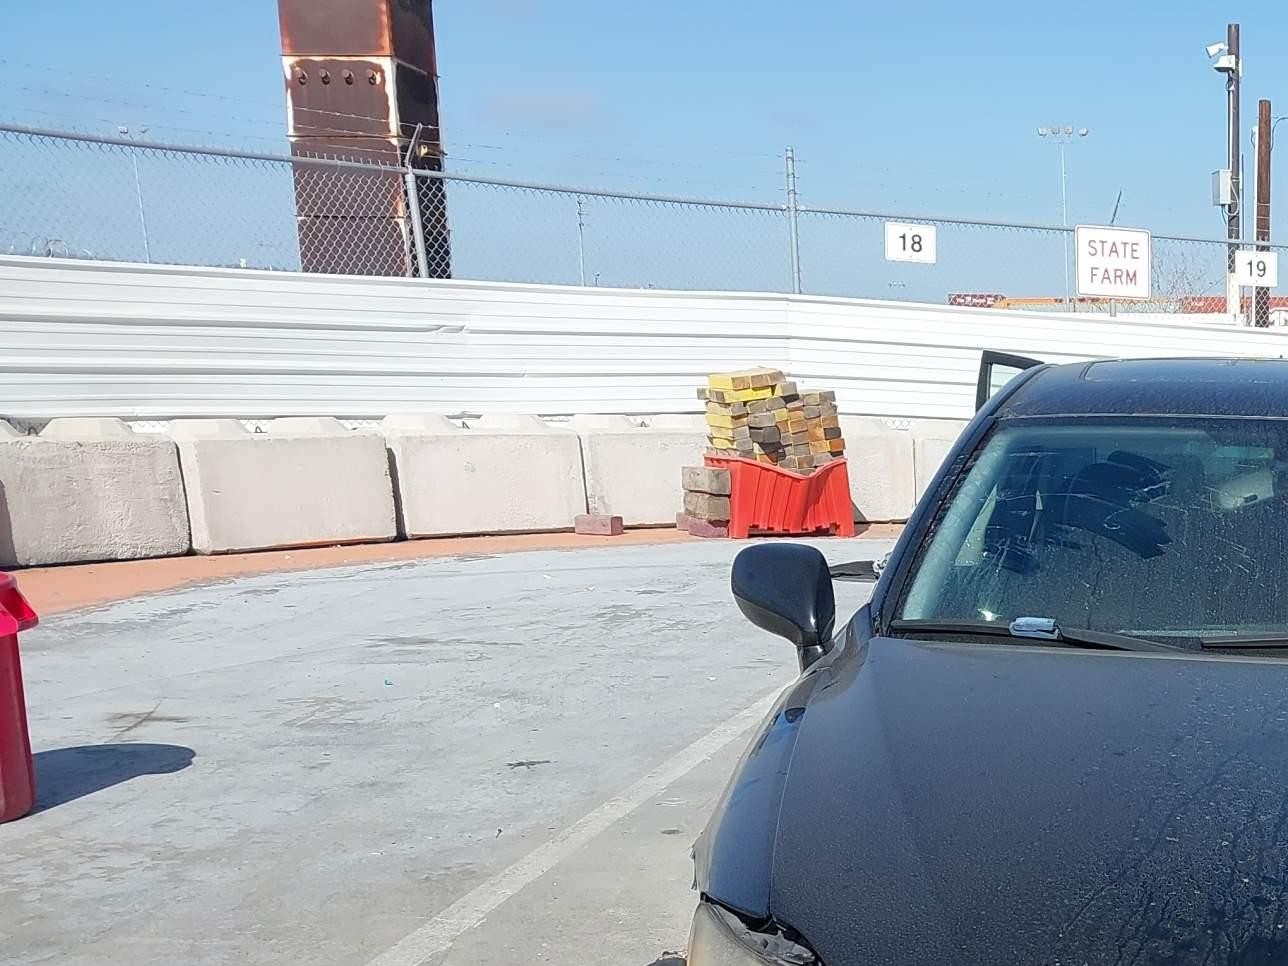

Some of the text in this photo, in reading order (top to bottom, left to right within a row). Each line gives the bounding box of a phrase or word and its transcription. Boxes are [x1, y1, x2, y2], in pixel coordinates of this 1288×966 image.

[898, 233, 924, 254] 18
[1087, 239, 1140, 261] STATE
[1089, 265, 1138, 287] FARM
[1245, 259, 1267, 279] 19
